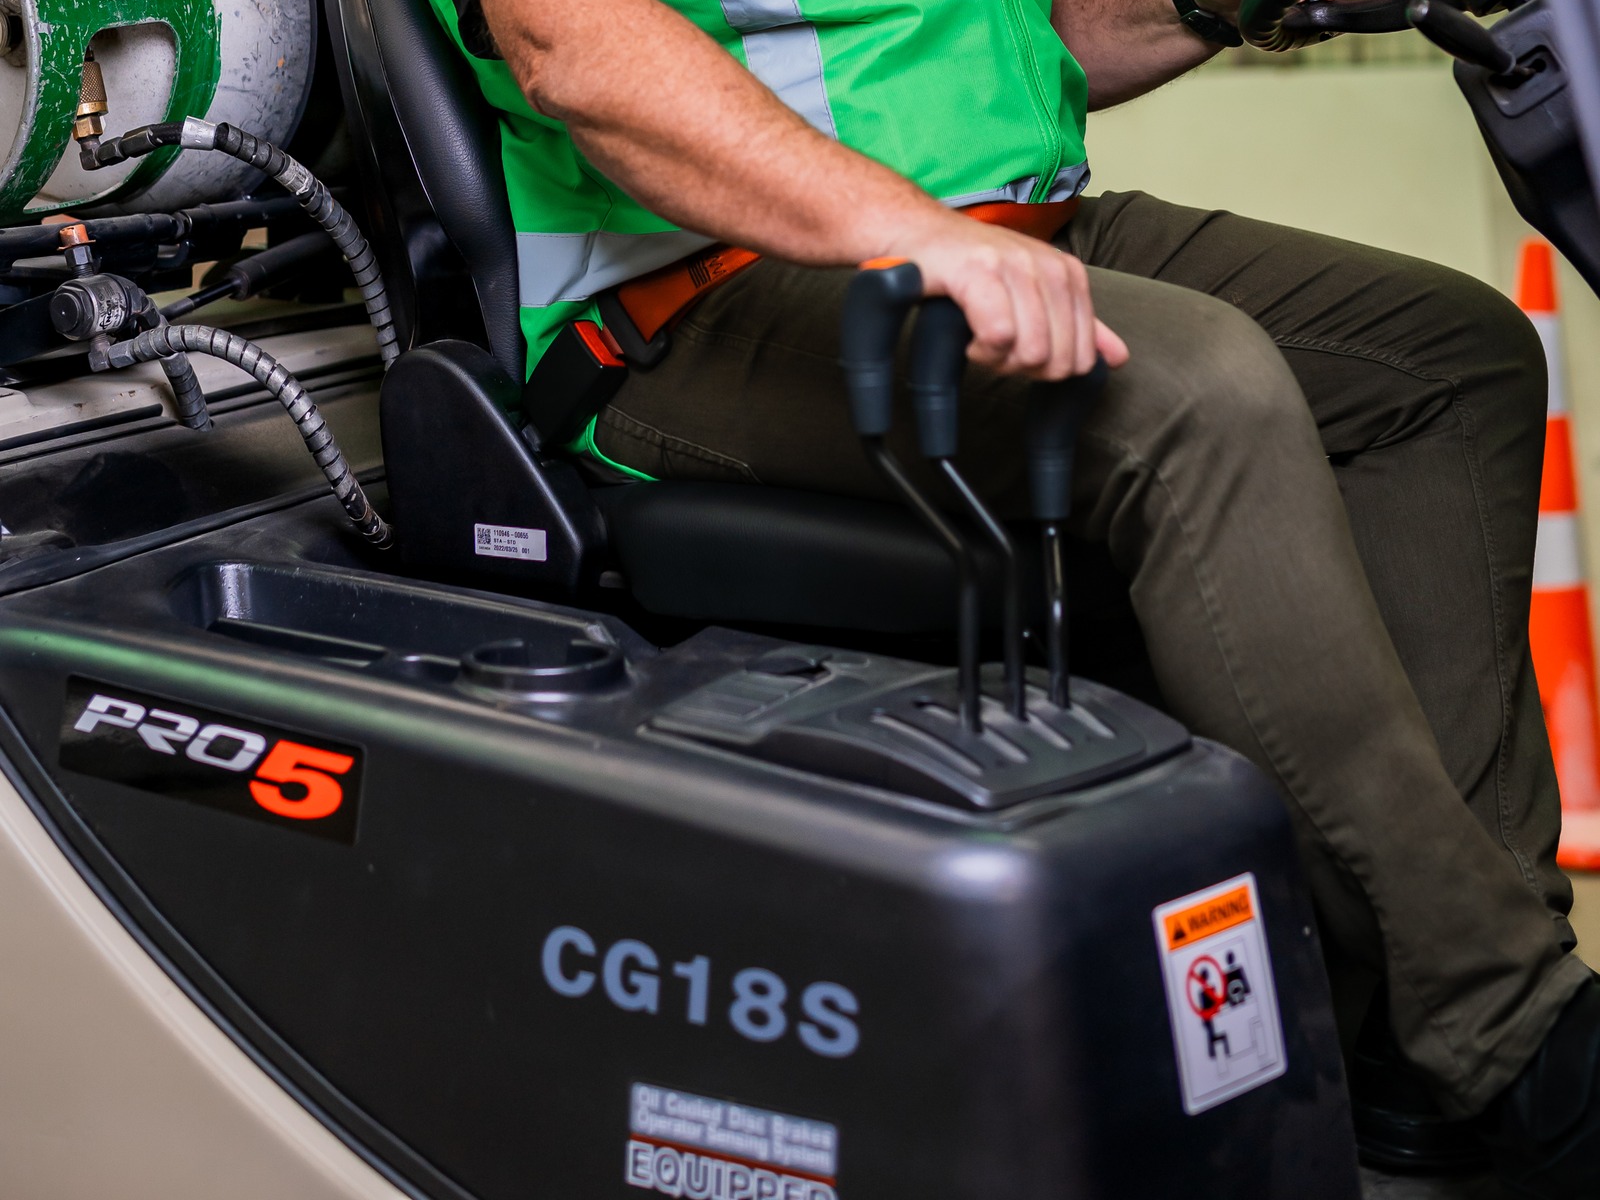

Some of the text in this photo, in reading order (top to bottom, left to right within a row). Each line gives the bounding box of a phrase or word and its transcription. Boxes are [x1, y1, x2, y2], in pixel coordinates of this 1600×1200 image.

[1187, 893, 1250, 933] WARNING
[541, 925, 861, 1058] CG18S
[637, 1107, 702, 1140] Operator
[707, 1124, 769, 1160] Sensing
[638, 1086, 659, 1108] Oil
[666, 1093, 722, 1122] Cooled
[773, 1116, 832, 1147] Brakes
